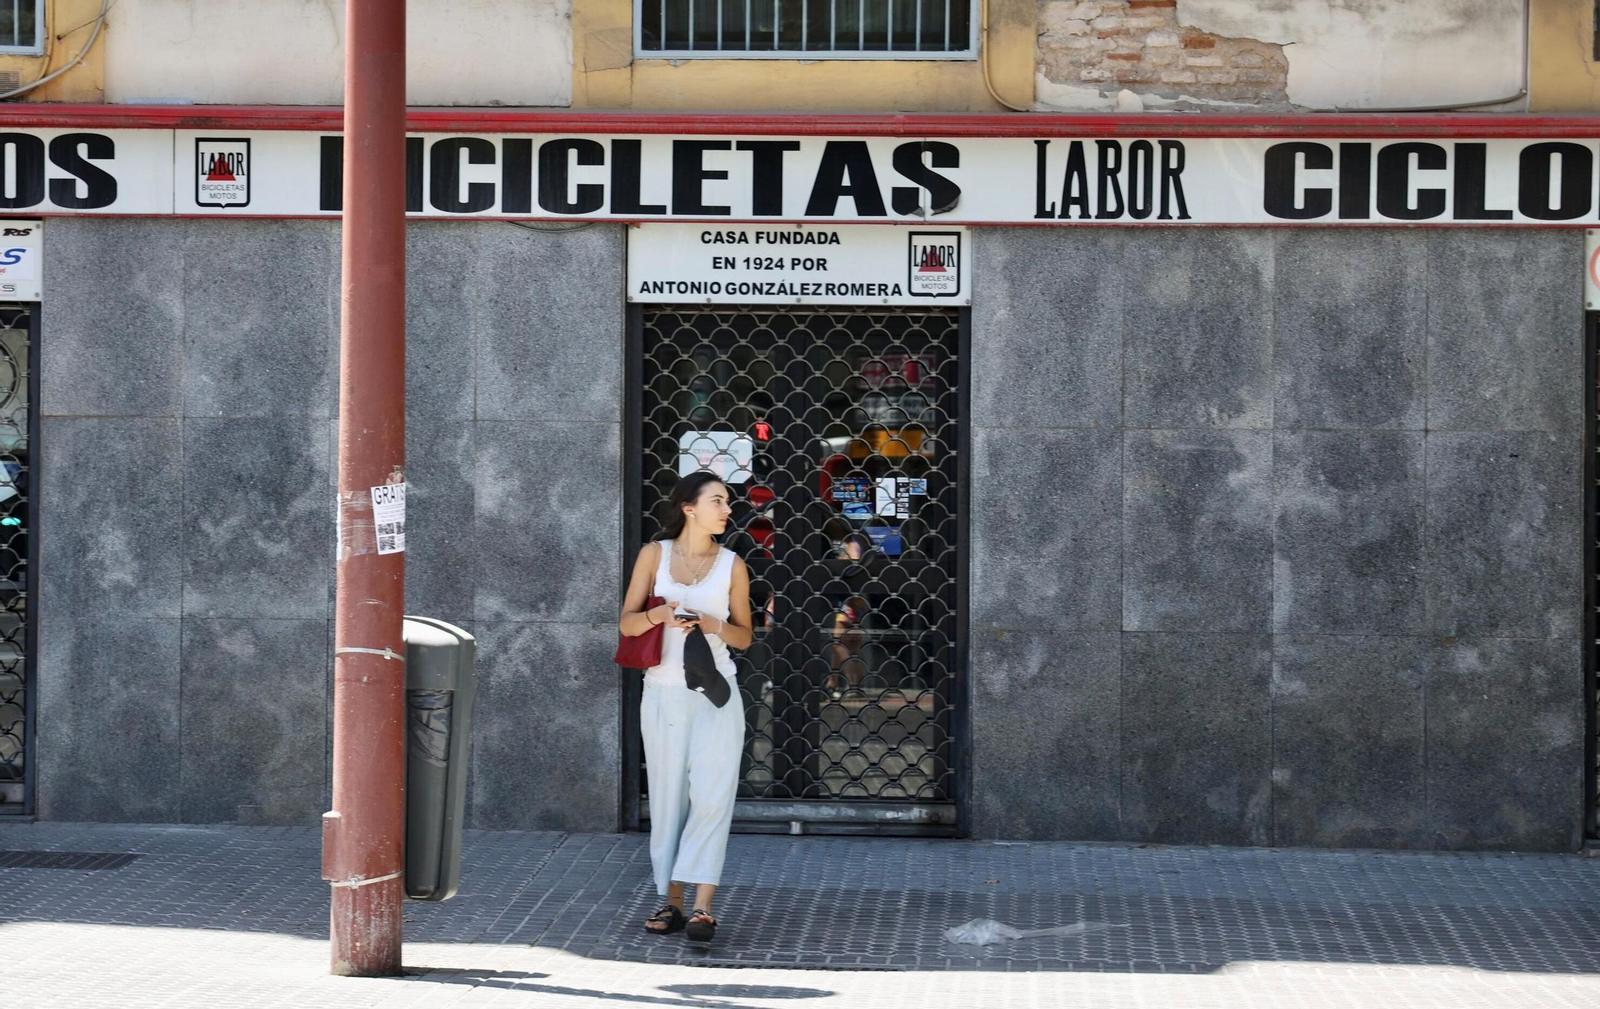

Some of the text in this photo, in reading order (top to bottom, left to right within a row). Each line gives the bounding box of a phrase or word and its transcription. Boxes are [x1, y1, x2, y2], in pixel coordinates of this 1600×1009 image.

[0, 133, 117, 209] OS
[200, 152, 246, 176] LABOR
[201, 183, 245, 191] BICICLETAS
[1033, 139, 1192, 220] LABOR
[1263, 142, 1600, 221] CICLO
[701, 231, 840, 244] CASA FUNDADA
[713, 257, 827, 270] EN 1924 POR
[913, 244, 956, 267] LABOR
[640, 280, 902, 296] ANTONIO GONZÁLEZ ROMERA
